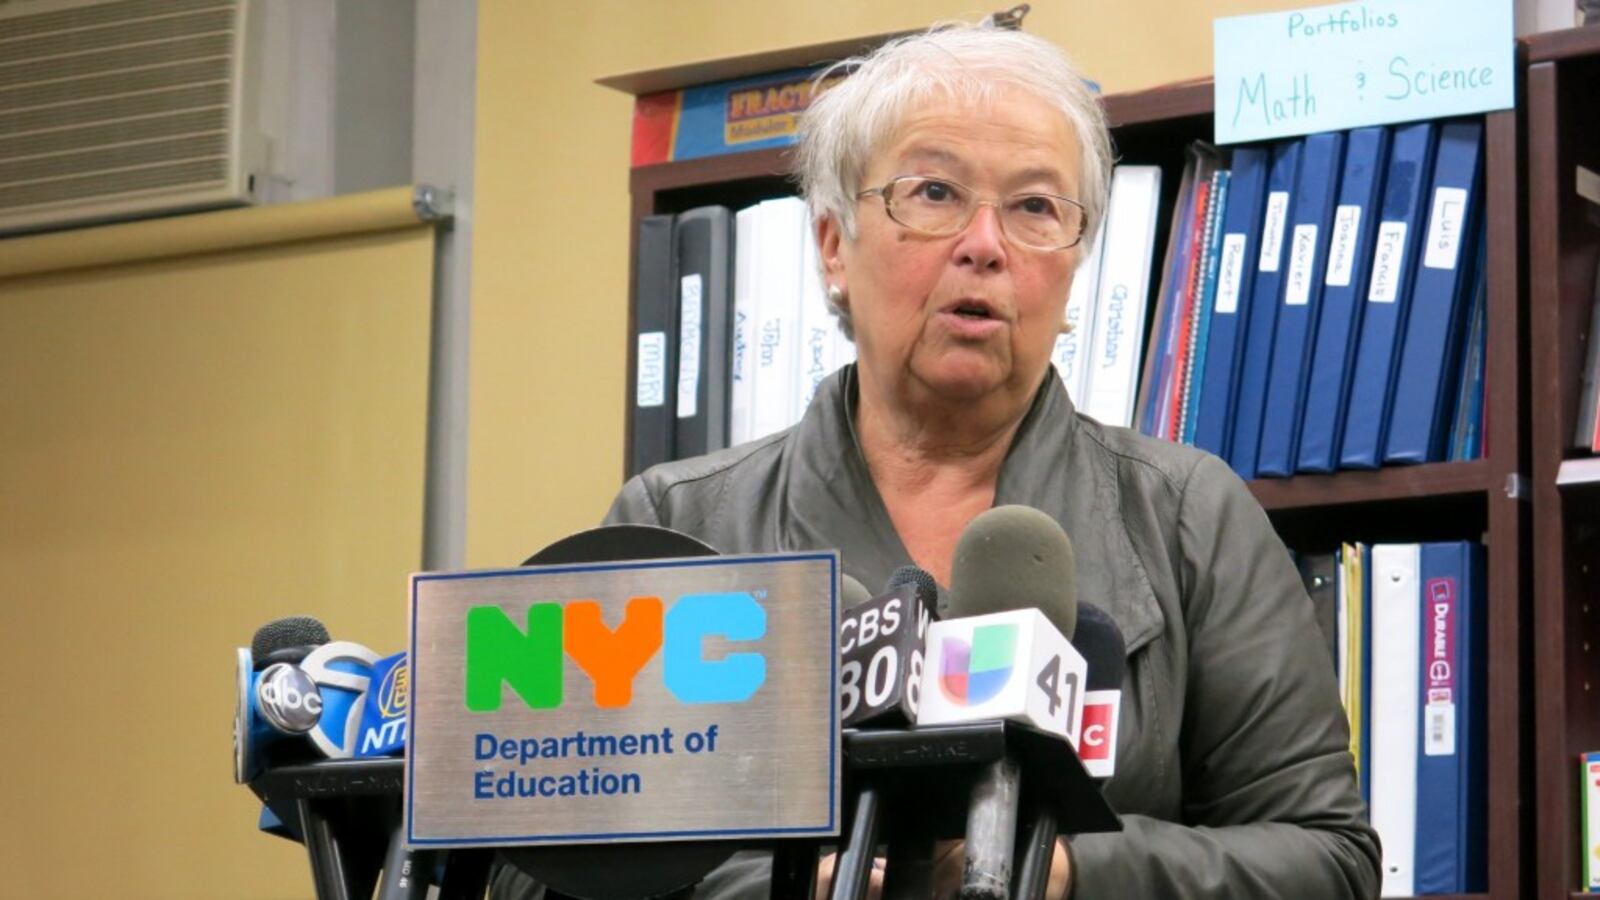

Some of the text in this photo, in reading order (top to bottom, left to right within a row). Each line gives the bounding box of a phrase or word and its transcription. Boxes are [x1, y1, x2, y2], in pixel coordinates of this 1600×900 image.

[1288, 10, 1399, 38] Portfolios
[1233, 72, 1317, 127] Math
[1385, 57, 1494, 101] Science
[1334, 208, 1356, 275] Joanna
[1439, 200, 1461, 250] Luis
[1294, 232, 1312, 291] Xavier
[1375, 231, 1400, 297] Francis
[760, 318, 781, 368] John
[465, 592, 767, 712] NYC
[1434, 603, 1449, 658] DURABLE
[259, 668, 323, 715] abc
[1036, 653, 1078, 736] 41
[475, 725, 718, 765] Department of
[474, 768, 641, 799] Education
